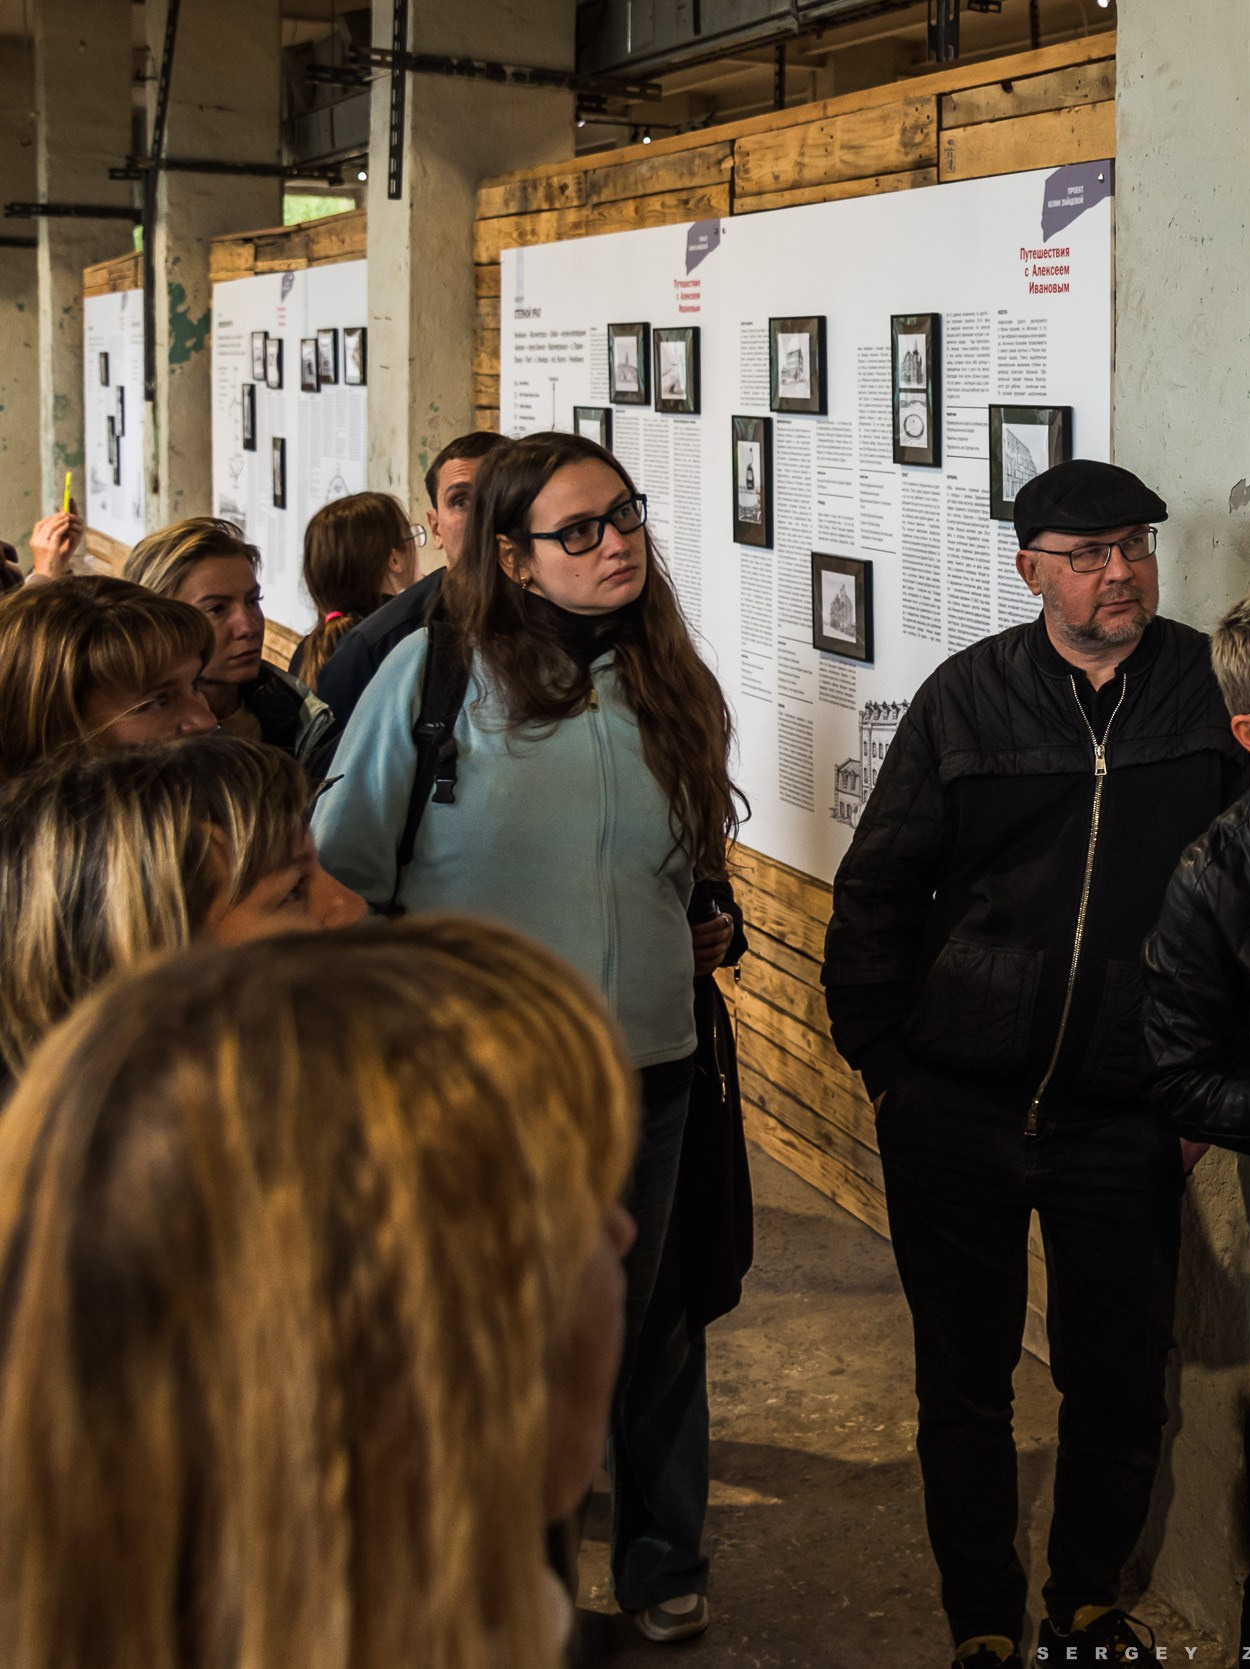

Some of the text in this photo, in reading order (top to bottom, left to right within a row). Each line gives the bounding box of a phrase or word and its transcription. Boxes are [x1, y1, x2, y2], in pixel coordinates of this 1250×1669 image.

[1020, 247, 1069, 262] Путешествия
[1024, 264, 1069, 277] с Алексеем
[1029, 281, 1069, 293] Ивановым
